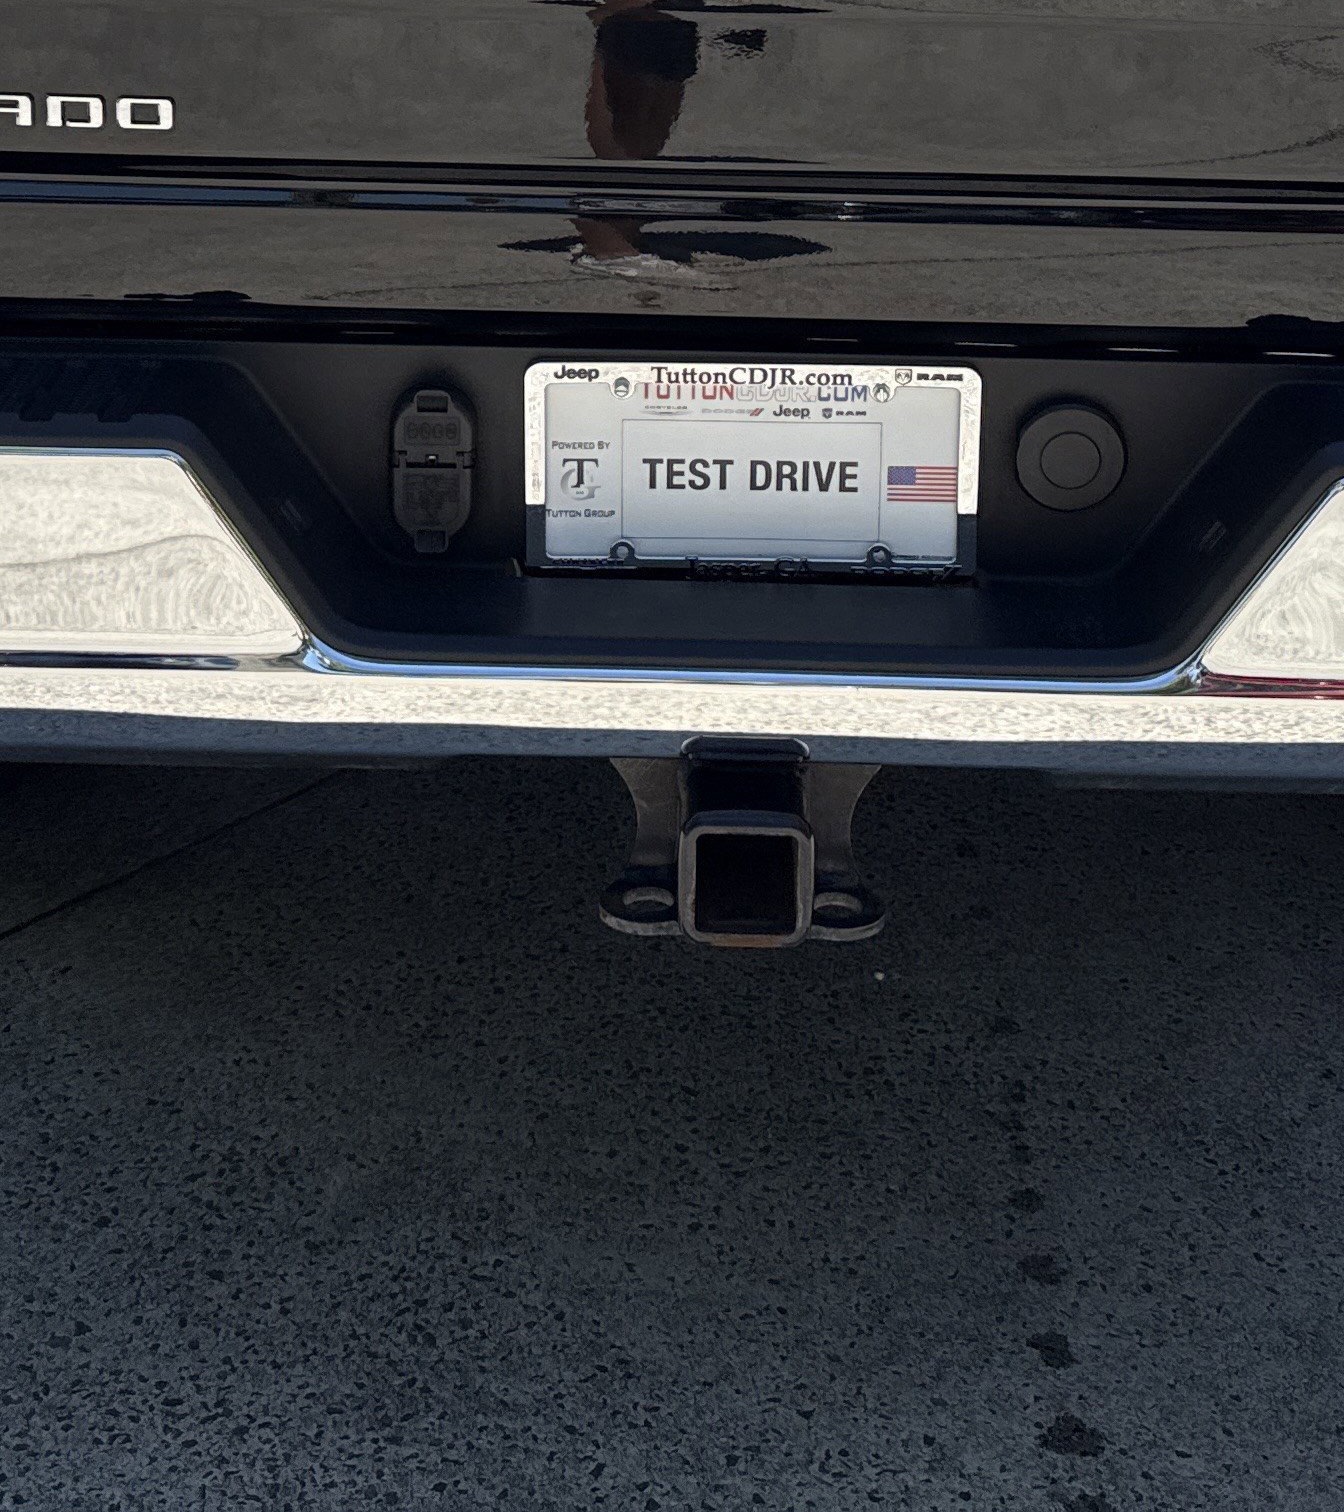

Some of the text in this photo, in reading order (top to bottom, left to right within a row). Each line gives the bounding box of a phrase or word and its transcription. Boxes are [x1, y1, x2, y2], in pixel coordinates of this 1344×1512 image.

[553, 365, 964, 389] Jeep TuttonCDJR.com RAM
[773, 404, 811, 419] Jeep
[642, 458, 859, 493] TEST DRIVE
